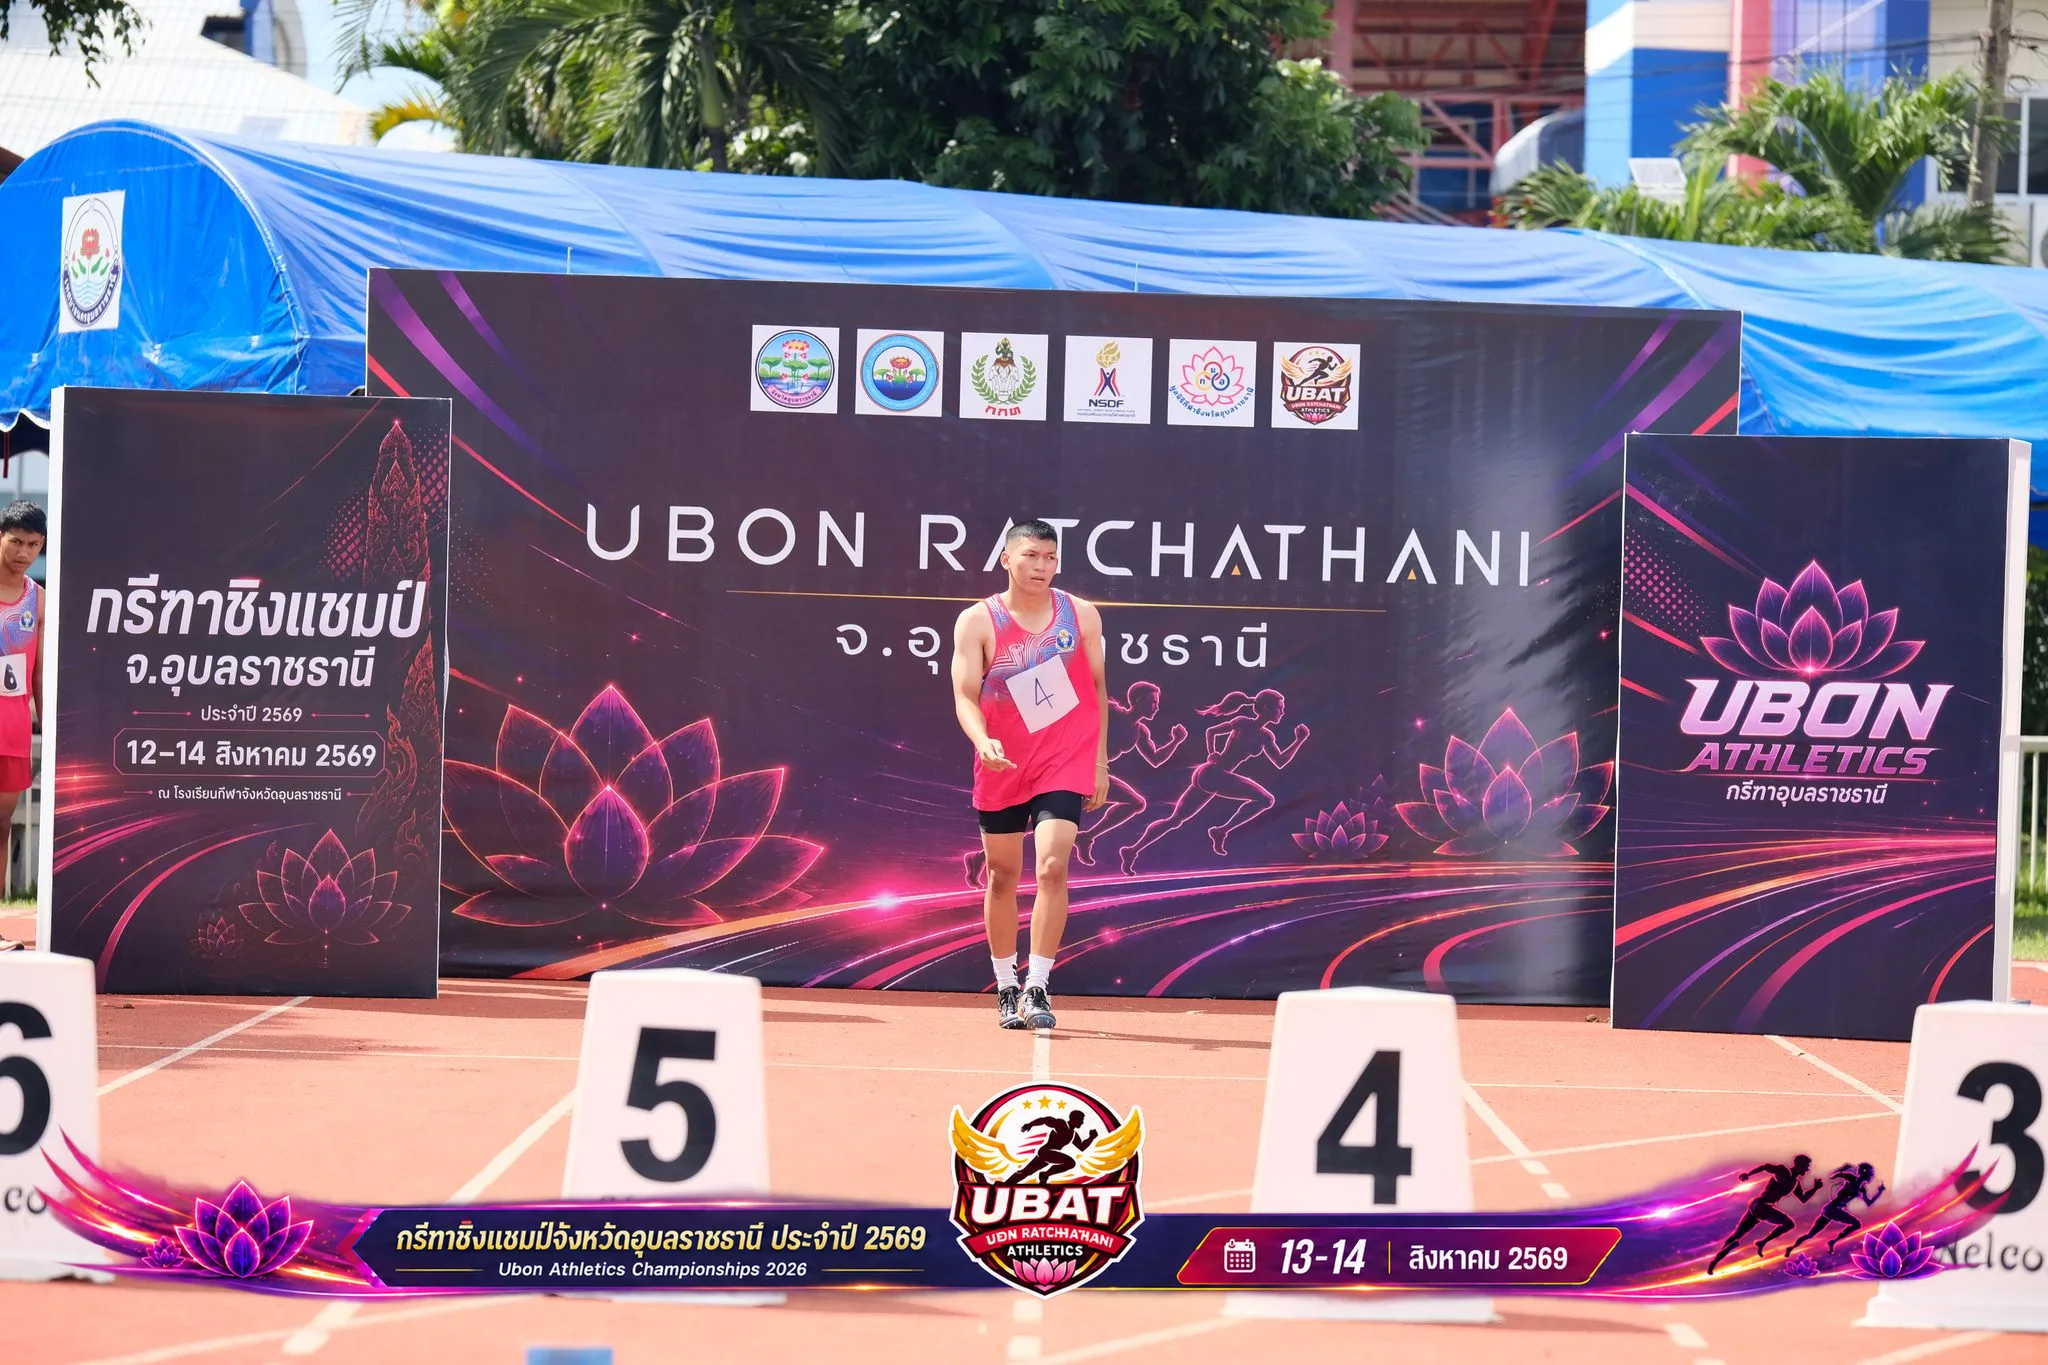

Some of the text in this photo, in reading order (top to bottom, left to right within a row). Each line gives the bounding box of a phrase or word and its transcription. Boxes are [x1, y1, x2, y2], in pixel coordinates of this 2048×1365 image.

[1088, 398, 1124, 408] NSDF
[1286, 386, 1346, 403] UBAT
[586, 503, 866, 568] UBON
[86, 573, 427, 638] กรีฑาชิงแชมป์
[4, 663, 18, 691] 6
[126, 646, 376, 697] จ.อุบลราชธานี
[1034, 677, 1054, 709] 4
[1679, 678, 1954, 741] UBON
[201, 704, 302, 722] ประจำปี 2569
[215, 740, 306, 767] สิงหาคม
[315, 744, 377, 767] 2569
[1676, 742, 1940, 776] ATHLETICS
[158, 785, 342, 804] ณ โรงเรียนกีฬาจังหวัดอุบลราชธานี
[1725, 780, 1888, 808] กรีฑาอุบลราชธานี
[0, 1001, 53, 1156] 6
[619, 1026, 718, 1183] 5
[1314, 1049, 1413, 1205] 4
[1953, 1061, 2046, 1215] 3
